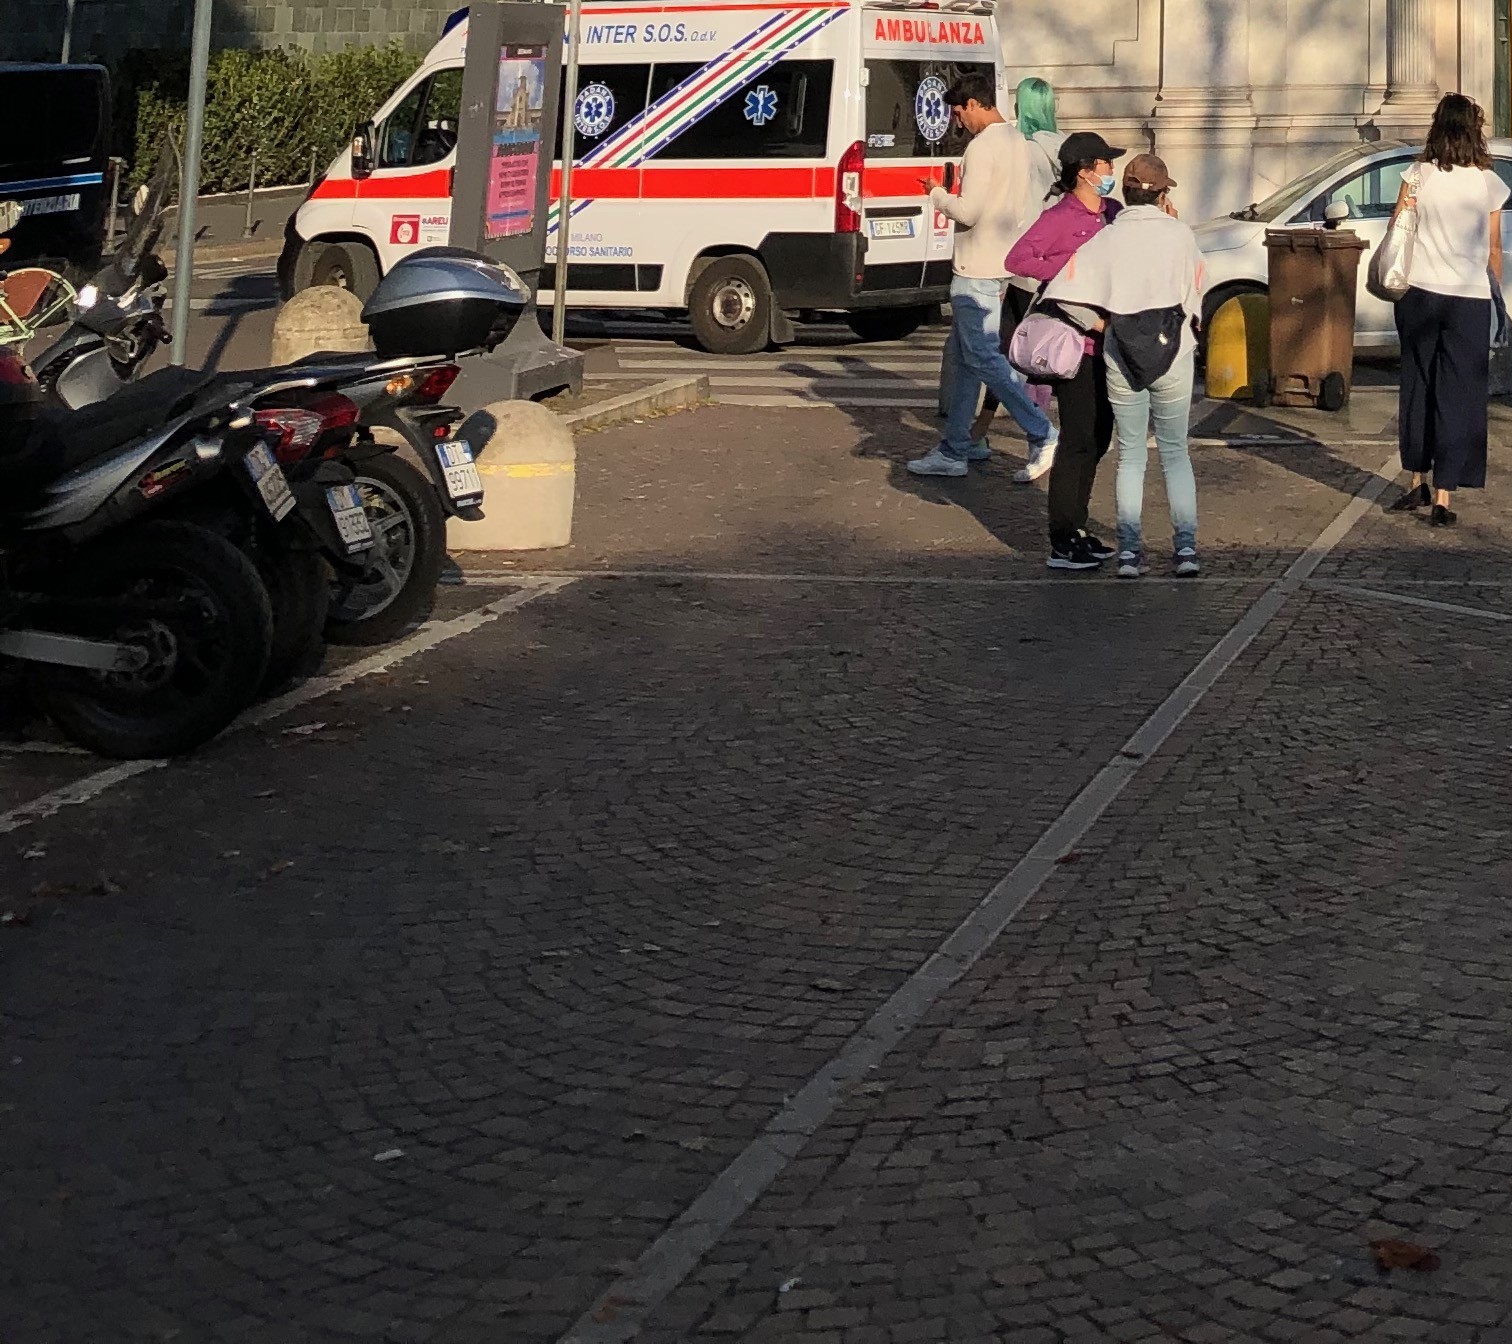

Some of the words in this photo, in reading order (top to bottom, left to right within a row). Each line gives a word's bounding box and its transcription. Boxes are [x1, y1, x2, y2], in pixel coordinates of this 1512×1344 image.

[586, 25, 638, 44] INTER
[643, 23, 688, 43] S.O.S.
[875, 18, 985, 45] AMBULANZA
[571, 233, 603, 243] MILANO
[588, 246, 633, 258] SANITARIO
